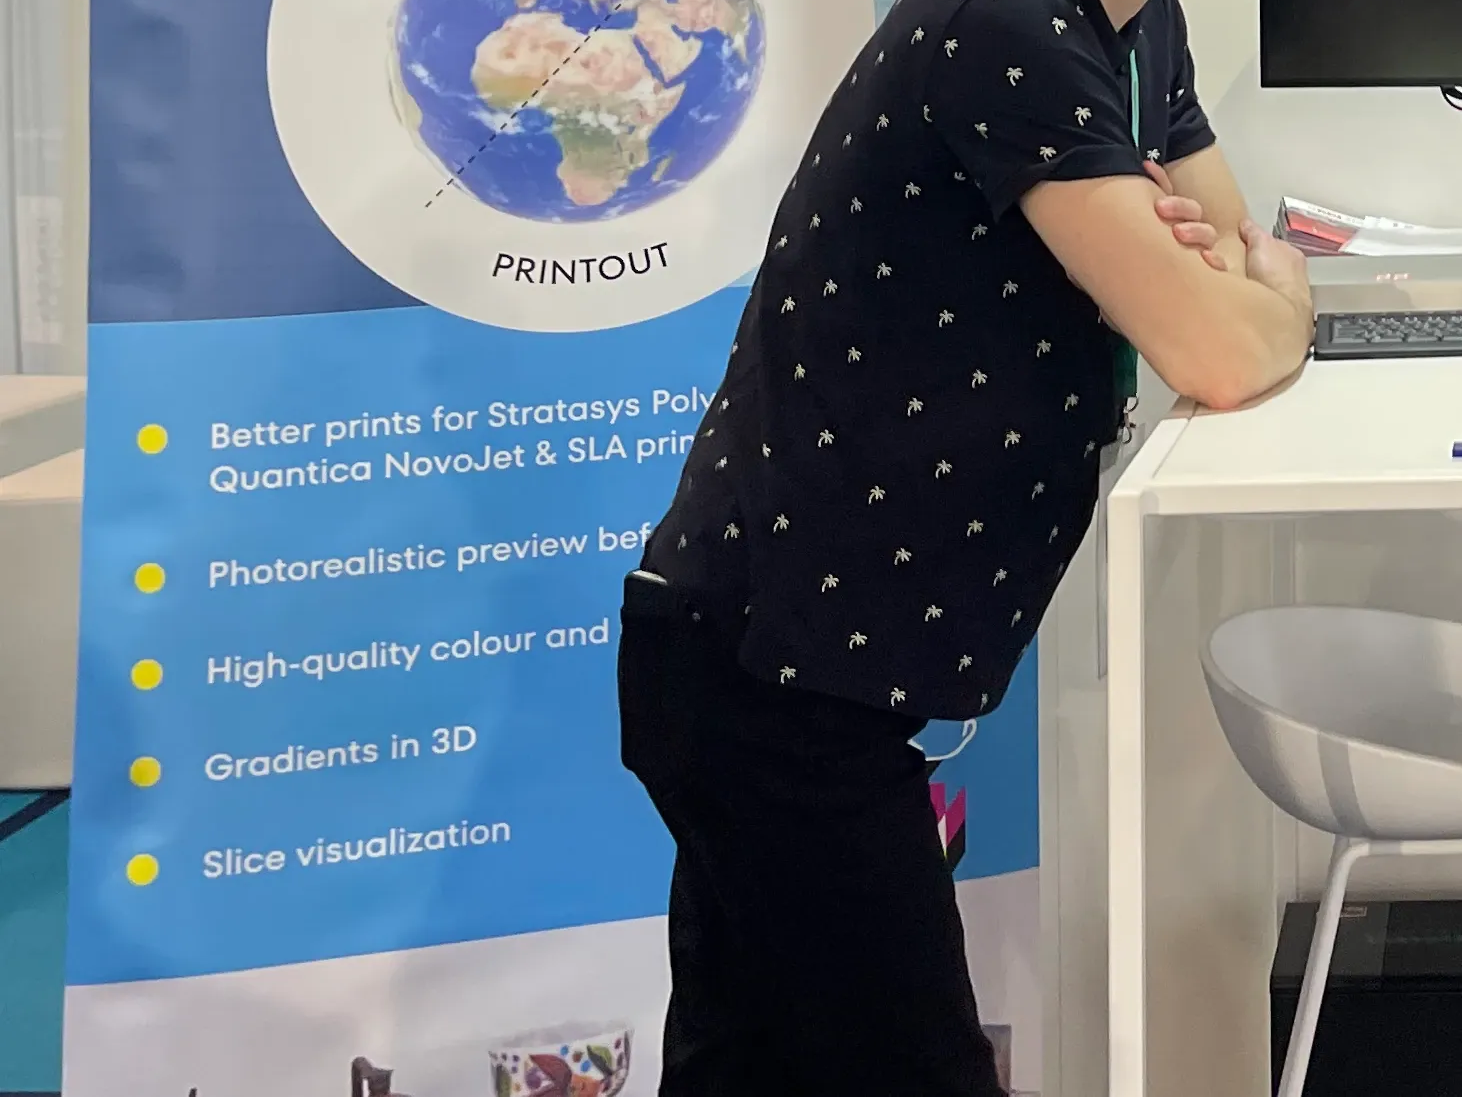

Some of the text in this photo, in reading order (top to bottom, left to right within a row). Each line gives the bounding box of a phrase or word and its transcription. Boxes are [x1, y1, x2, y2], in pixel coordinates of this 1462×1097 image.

[492, 242, 668, 285] PRINTOUT
[210, 421, 316, 450] Better
[325, 411, 422, 446] prints
[432, 406, 479, 433] for
[488, 395, 640, 428] Stratasys
[209, 456, 372, 494] Quantica
[385, 443, 526, 479] NovoJet
[535, 440, 558, 465] &
[568, 434, 628, 463] SLA
[208, 544, 447, 589] Photorealistic
[457, 533, 589, 572] preview
[207, 617, 609, 688] High-quality colour and
[204, 725, 477, 781] Gradients in 3D
[202, 819, 512, 878] Slice visualization
